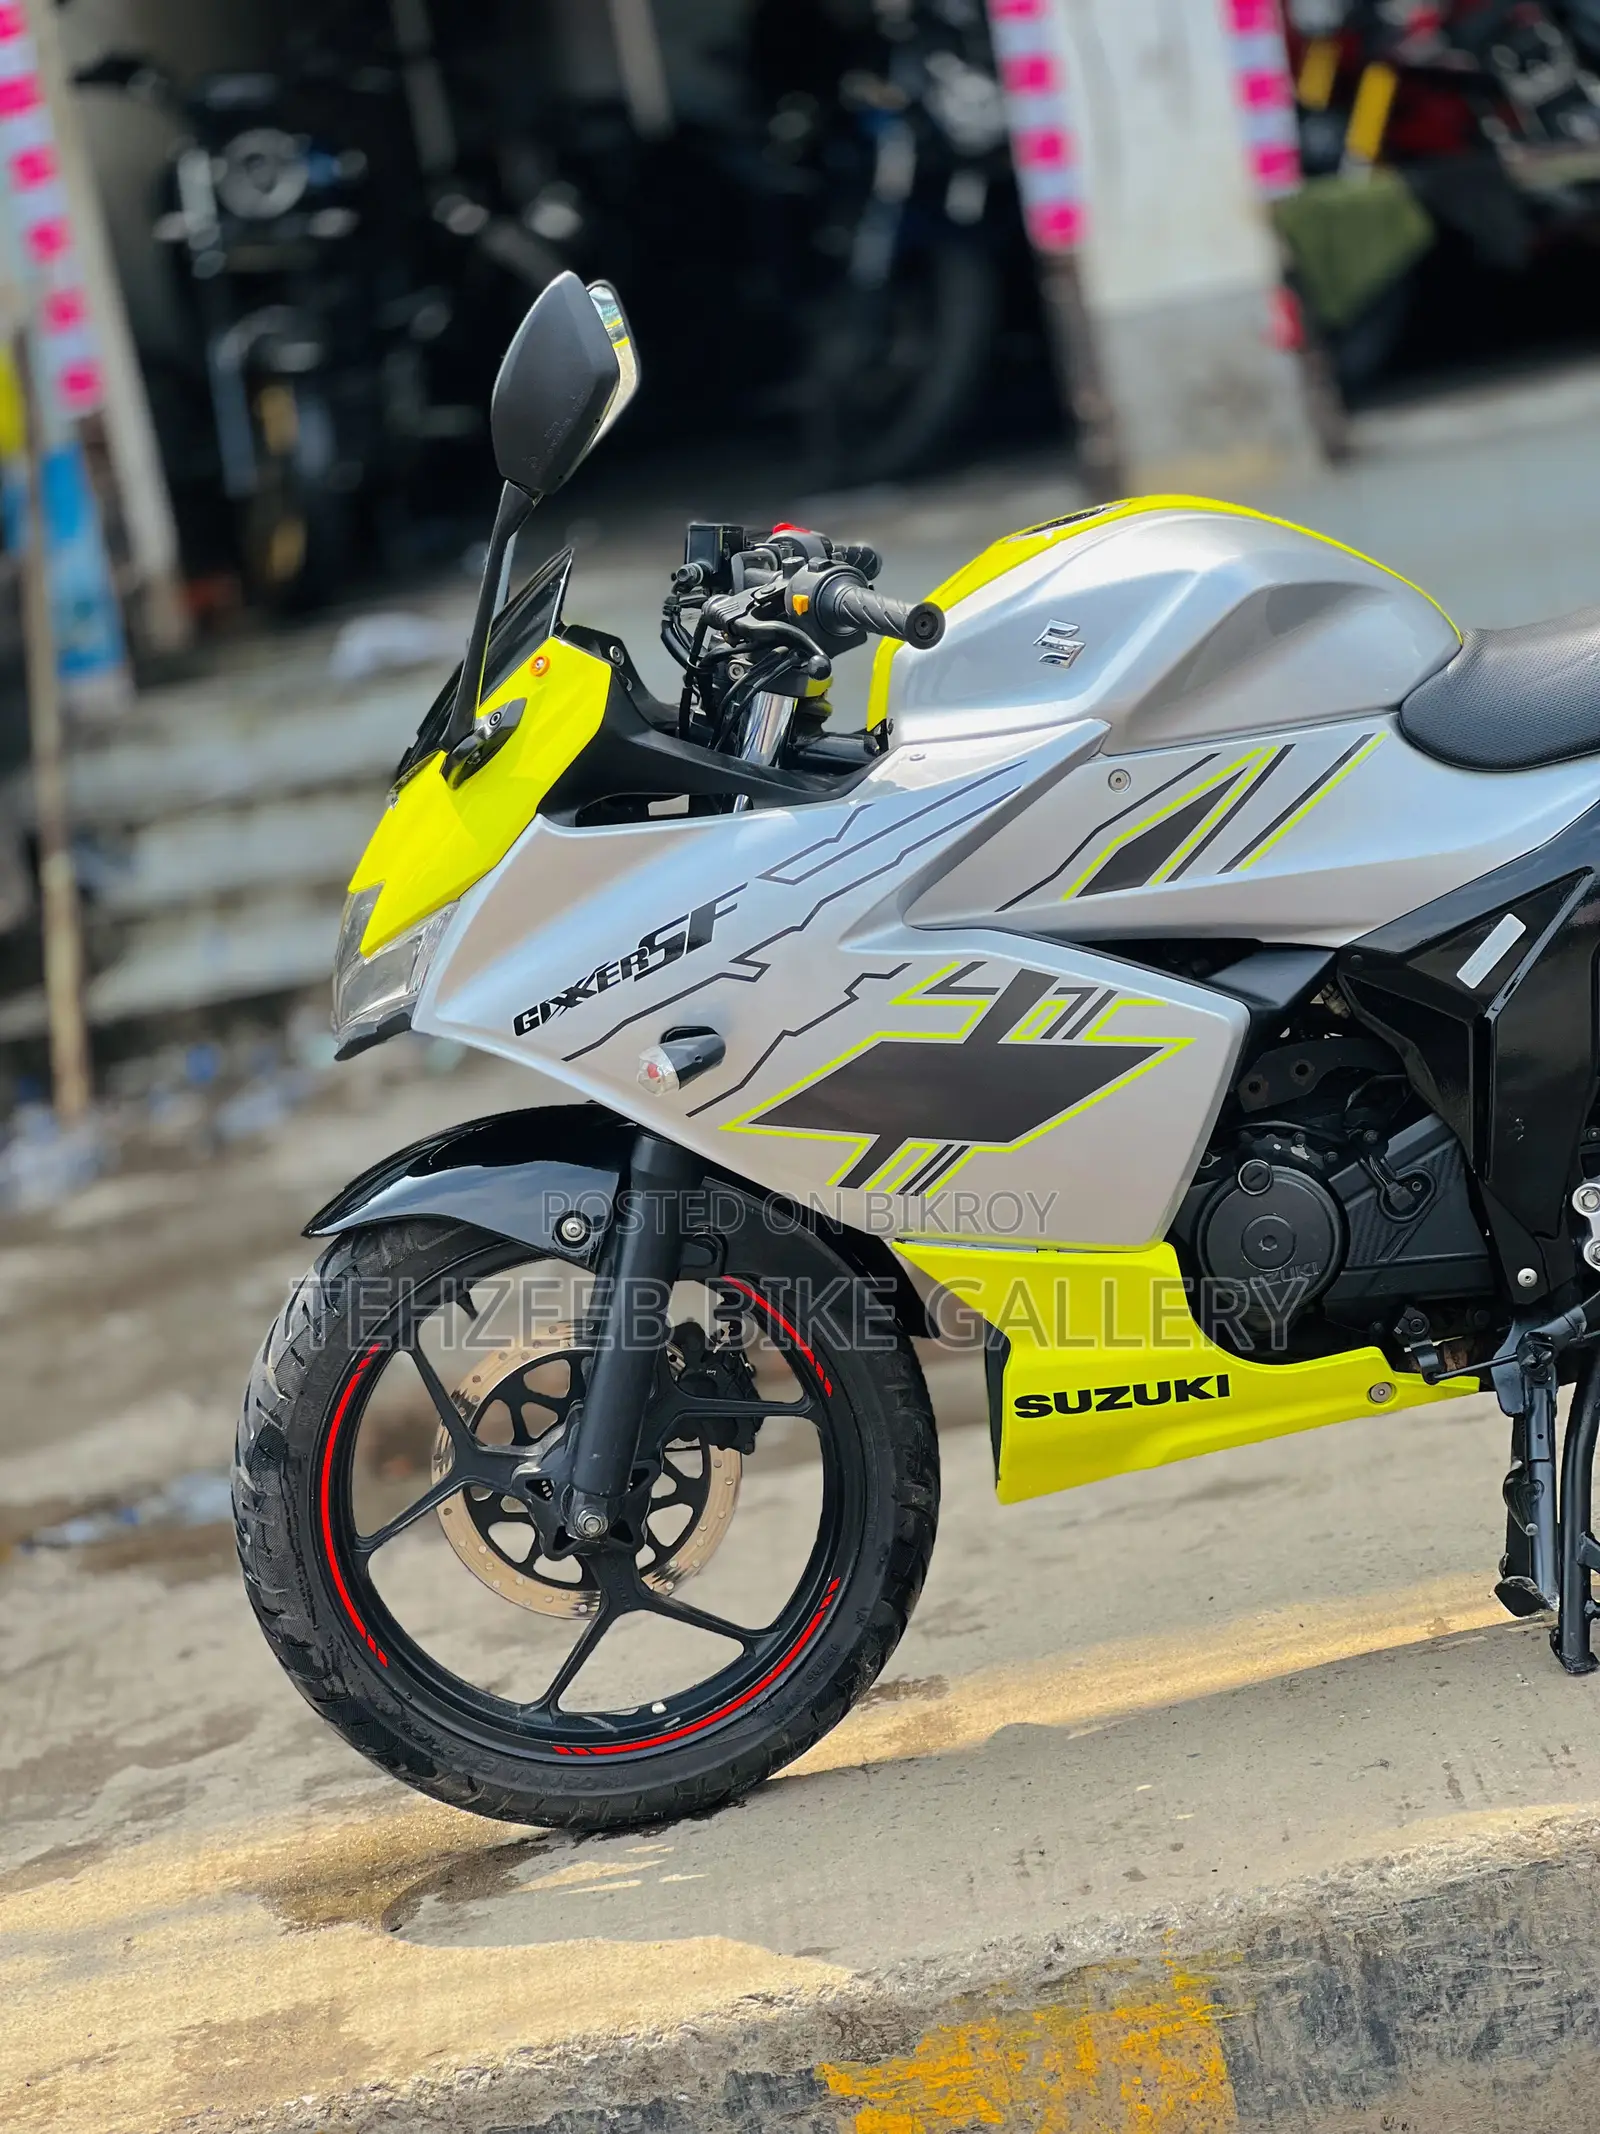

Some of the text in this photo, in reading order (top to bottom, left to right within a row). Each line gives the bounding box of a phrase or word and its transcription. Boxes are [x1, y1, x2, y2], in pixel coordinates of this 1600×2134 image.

[513, 881, 748, 1037] GIXXER SF
[1014, 1373, 1231, 1419] SUZUKI
